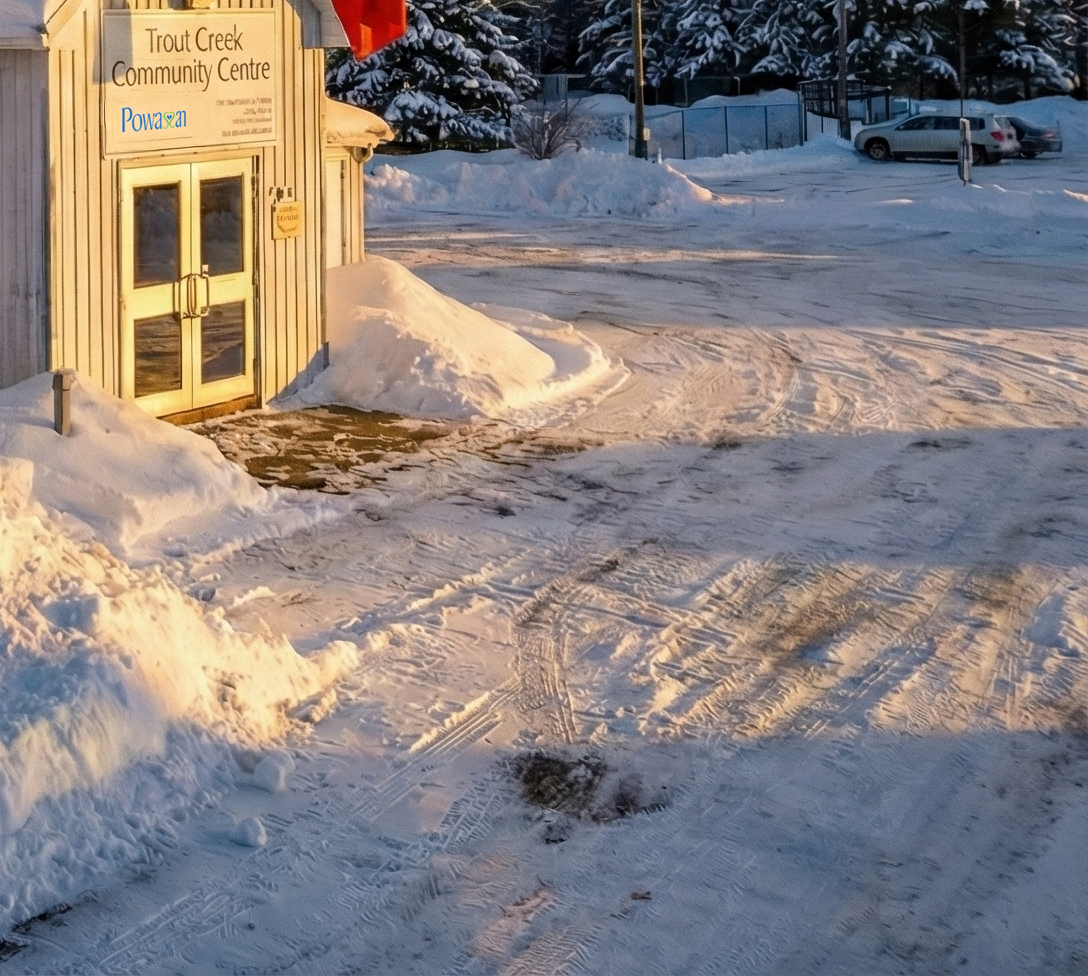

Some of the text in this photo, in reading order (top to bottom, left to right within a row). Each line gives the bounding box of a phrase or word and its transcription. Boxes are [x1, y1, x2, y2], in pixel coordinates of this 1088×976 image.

[145, 24, 243, 53] Trout Creek
[112, 57, 270, 91] Community Centre
